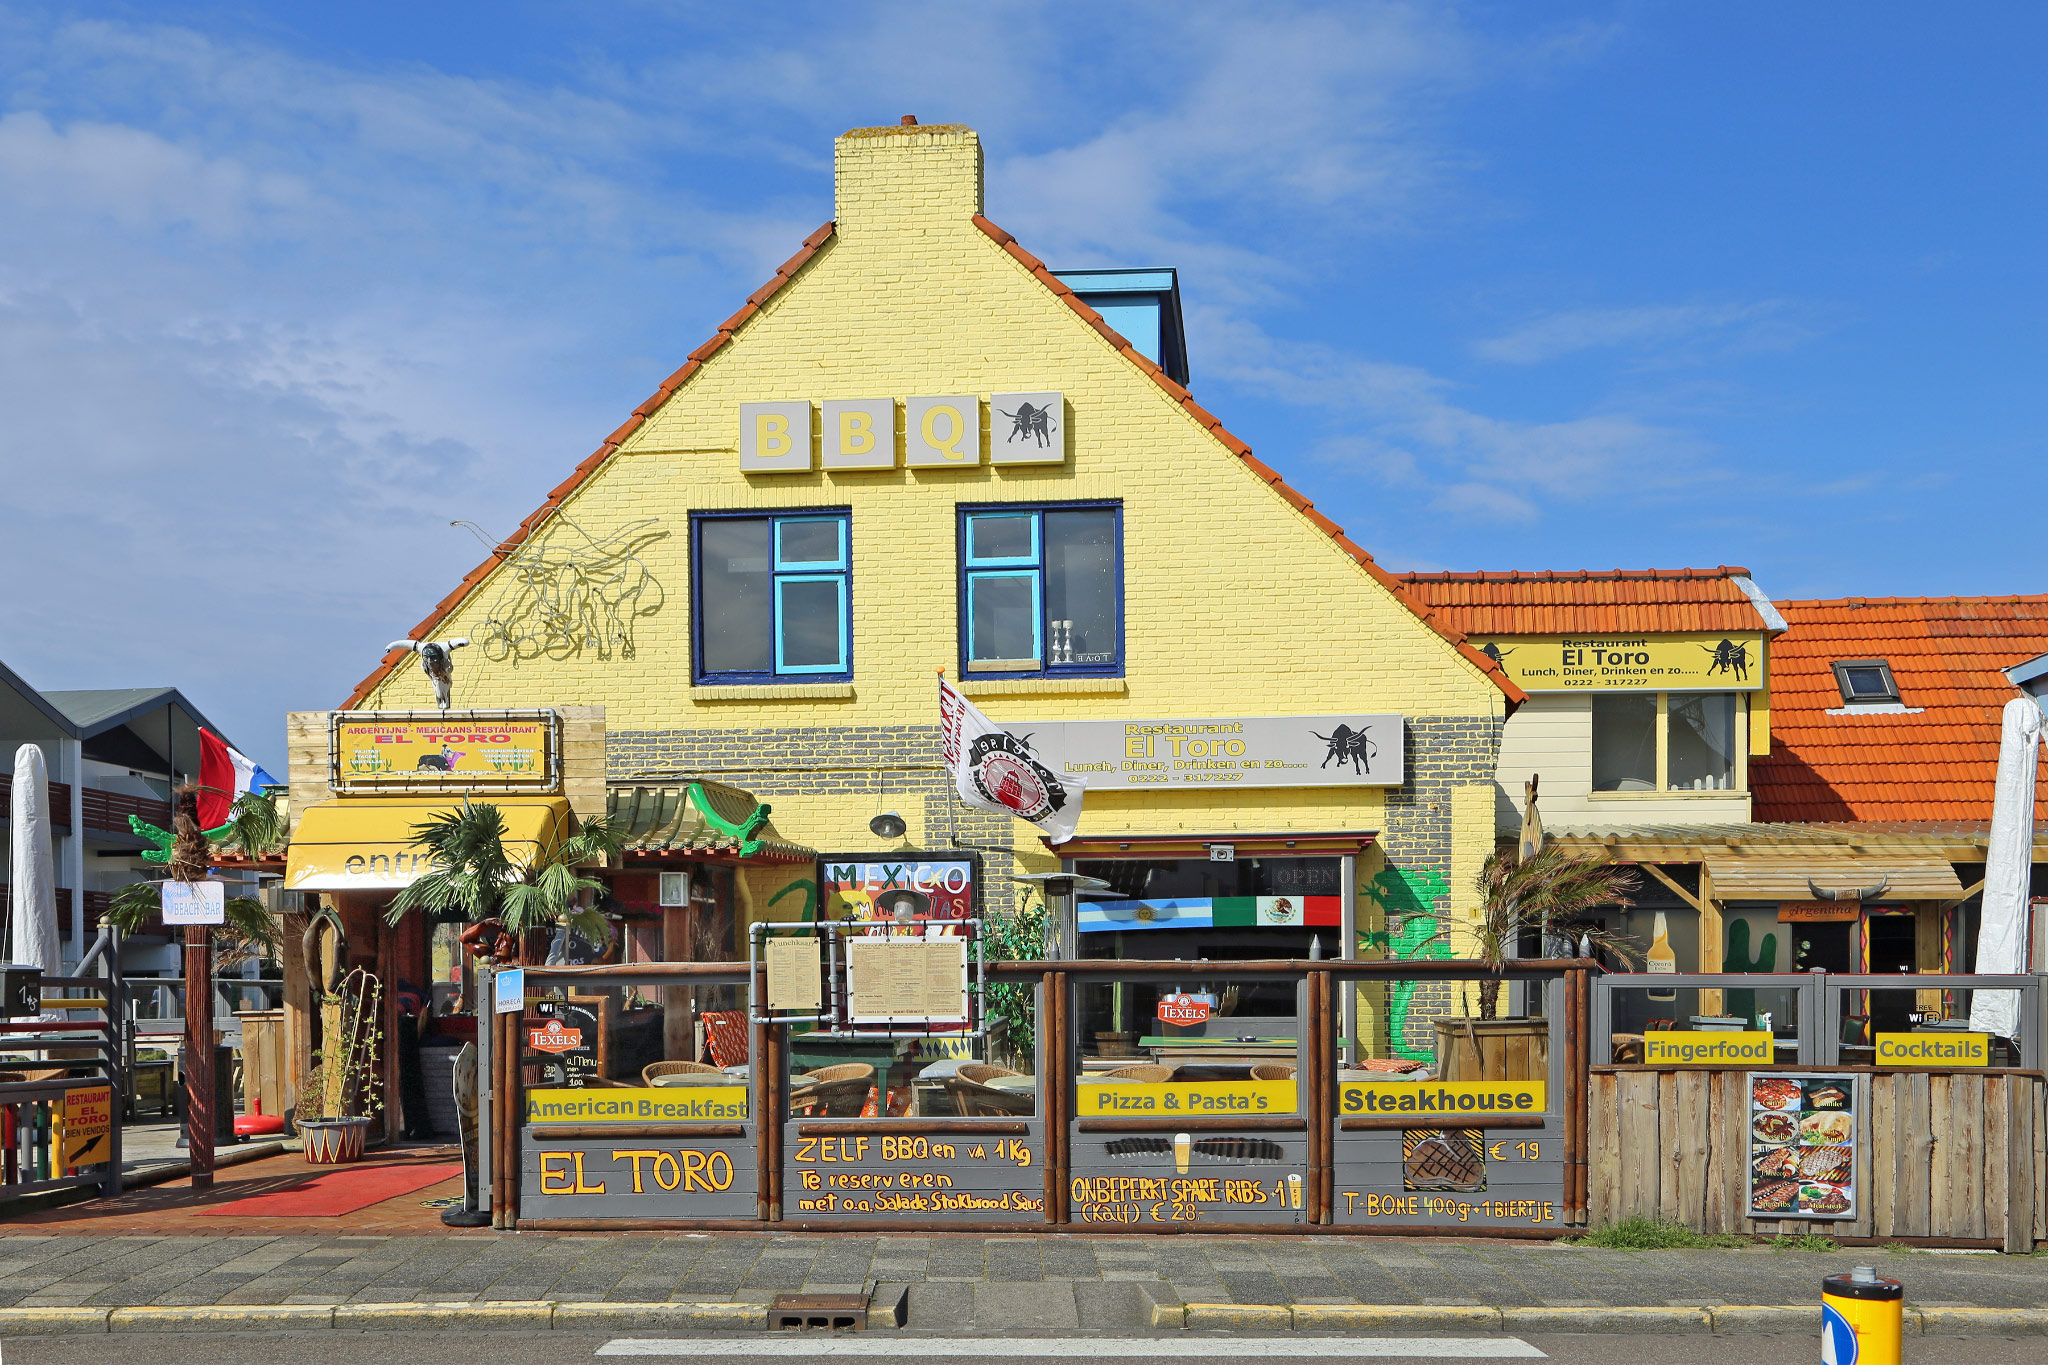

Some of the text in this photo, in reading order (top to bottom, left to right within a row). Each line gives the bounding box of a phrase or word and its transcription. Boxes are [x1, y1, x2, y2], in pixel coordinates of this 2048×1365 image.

[1562, 638, 1648, 648] Restaurant
[1562, 649, 1649, 665] El Toro
[1521, 666, 1559, 677] Lunch,
[1563, 666, 1597, 677] Diner,
[1601, 666, 1647, 675] Drinken
[1650, 667, 1664, 675] en
[1564, 678, 1593, 686] 0222
[1604, 678, 1648, 686] 317227
[347, 727, 408, 735] ARGENTIJNS
[416, 726, 472, 734] MEXICAANS
[475, 726, 538, 734] RESTAURANT
[1125, 722, 1243, 735] Restaurant
[375, 734, 511, 744] EL TORO
[1125, 736, 1246, 758] El Toro
[1064, 760, 1117, 773] Lunch,
[1121, 760, 1169, 773] Diner,
[1173, 758, 1237, 771] Drinken
[1241, 760, 1261, 770] en
[1128, 774, 1168, 783] 0222
[1184, 773, 1243, 782] 317227
[833, 864, 967, 894] MEXICO
[1277, 870, 1335, 884] OPEN
[174, 902, 221, 916] BEACH BAR
[1788, 904, 1852, 917] Argentina
[498, 998, 521, 1006] HORECA
[1160, 1005, 1206, 1019] TEXELS
[530, 1032, 577, 1046] TEXELS
[1648, 1041, 1767, 1062] Fingerfood
[1880, 1040, 1982, 1058] Cocktails
[66, 1091, 109, 1106] RESTAURANT
[1098, 1092, 1268, 1109] Pizza & Pasta's
[1344, 1089, 1534, 1112] Steakhouse
[81, 1106, 98, 1115] EL
[527, 1098, 748, 1117] American Breakfast
[68, 1114, 109, 1126] TORO
[65, 1125, 109, 1138] BIEN VENIDOS
[794, 1136, 870, 1162] ZELF
[1515, 1142, 1540, 1160] 19
[539, 1150, 734, 1195] EL TORO
[797, 1170, 821, 1189] Te
[1071, 1177, 1169, 1203] ONBEPERKT
[798, 1193, 838, 1212] met
[1495, 1200, 1554, 1223] BIERTJE
